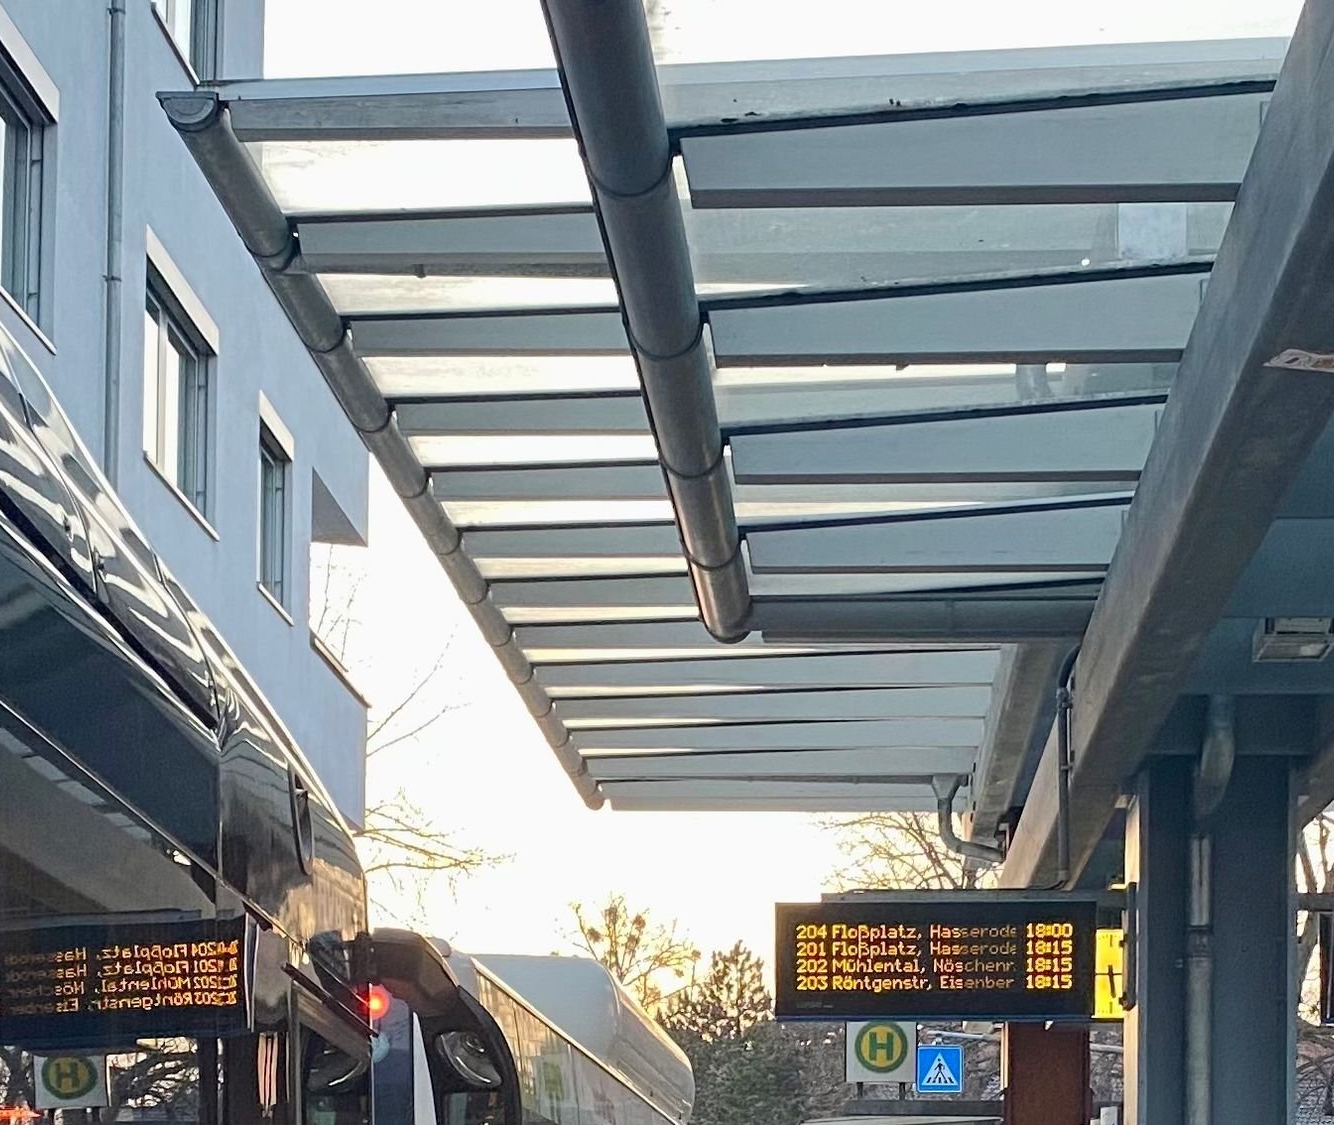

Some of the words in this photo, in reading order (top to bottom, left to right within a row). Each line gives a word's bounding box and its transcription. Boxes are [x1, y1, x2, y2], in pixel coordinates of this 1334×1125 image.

[795, 924, 828, 939] 204
[831, 923, 923, 943] Floßplatz,
[1026, 923, 1074, 939] 18:00
[795, 940, 827, 957] 201
[831, 940, 923, 960] Floßplatz,
[1026, 939, 1074, 956] 18:15
[795, 957, 829, 974] 202
[831, 957, 926, 975] Mühlental,
[1026, 957, 1074, 974] 18:15
[795, 974, 829, 991] 203
[831, 974, 933, 993] Röntgenstr,
[1025, 974, 1074, 990] 18:15
[868, 1031, 895, 1061] H
